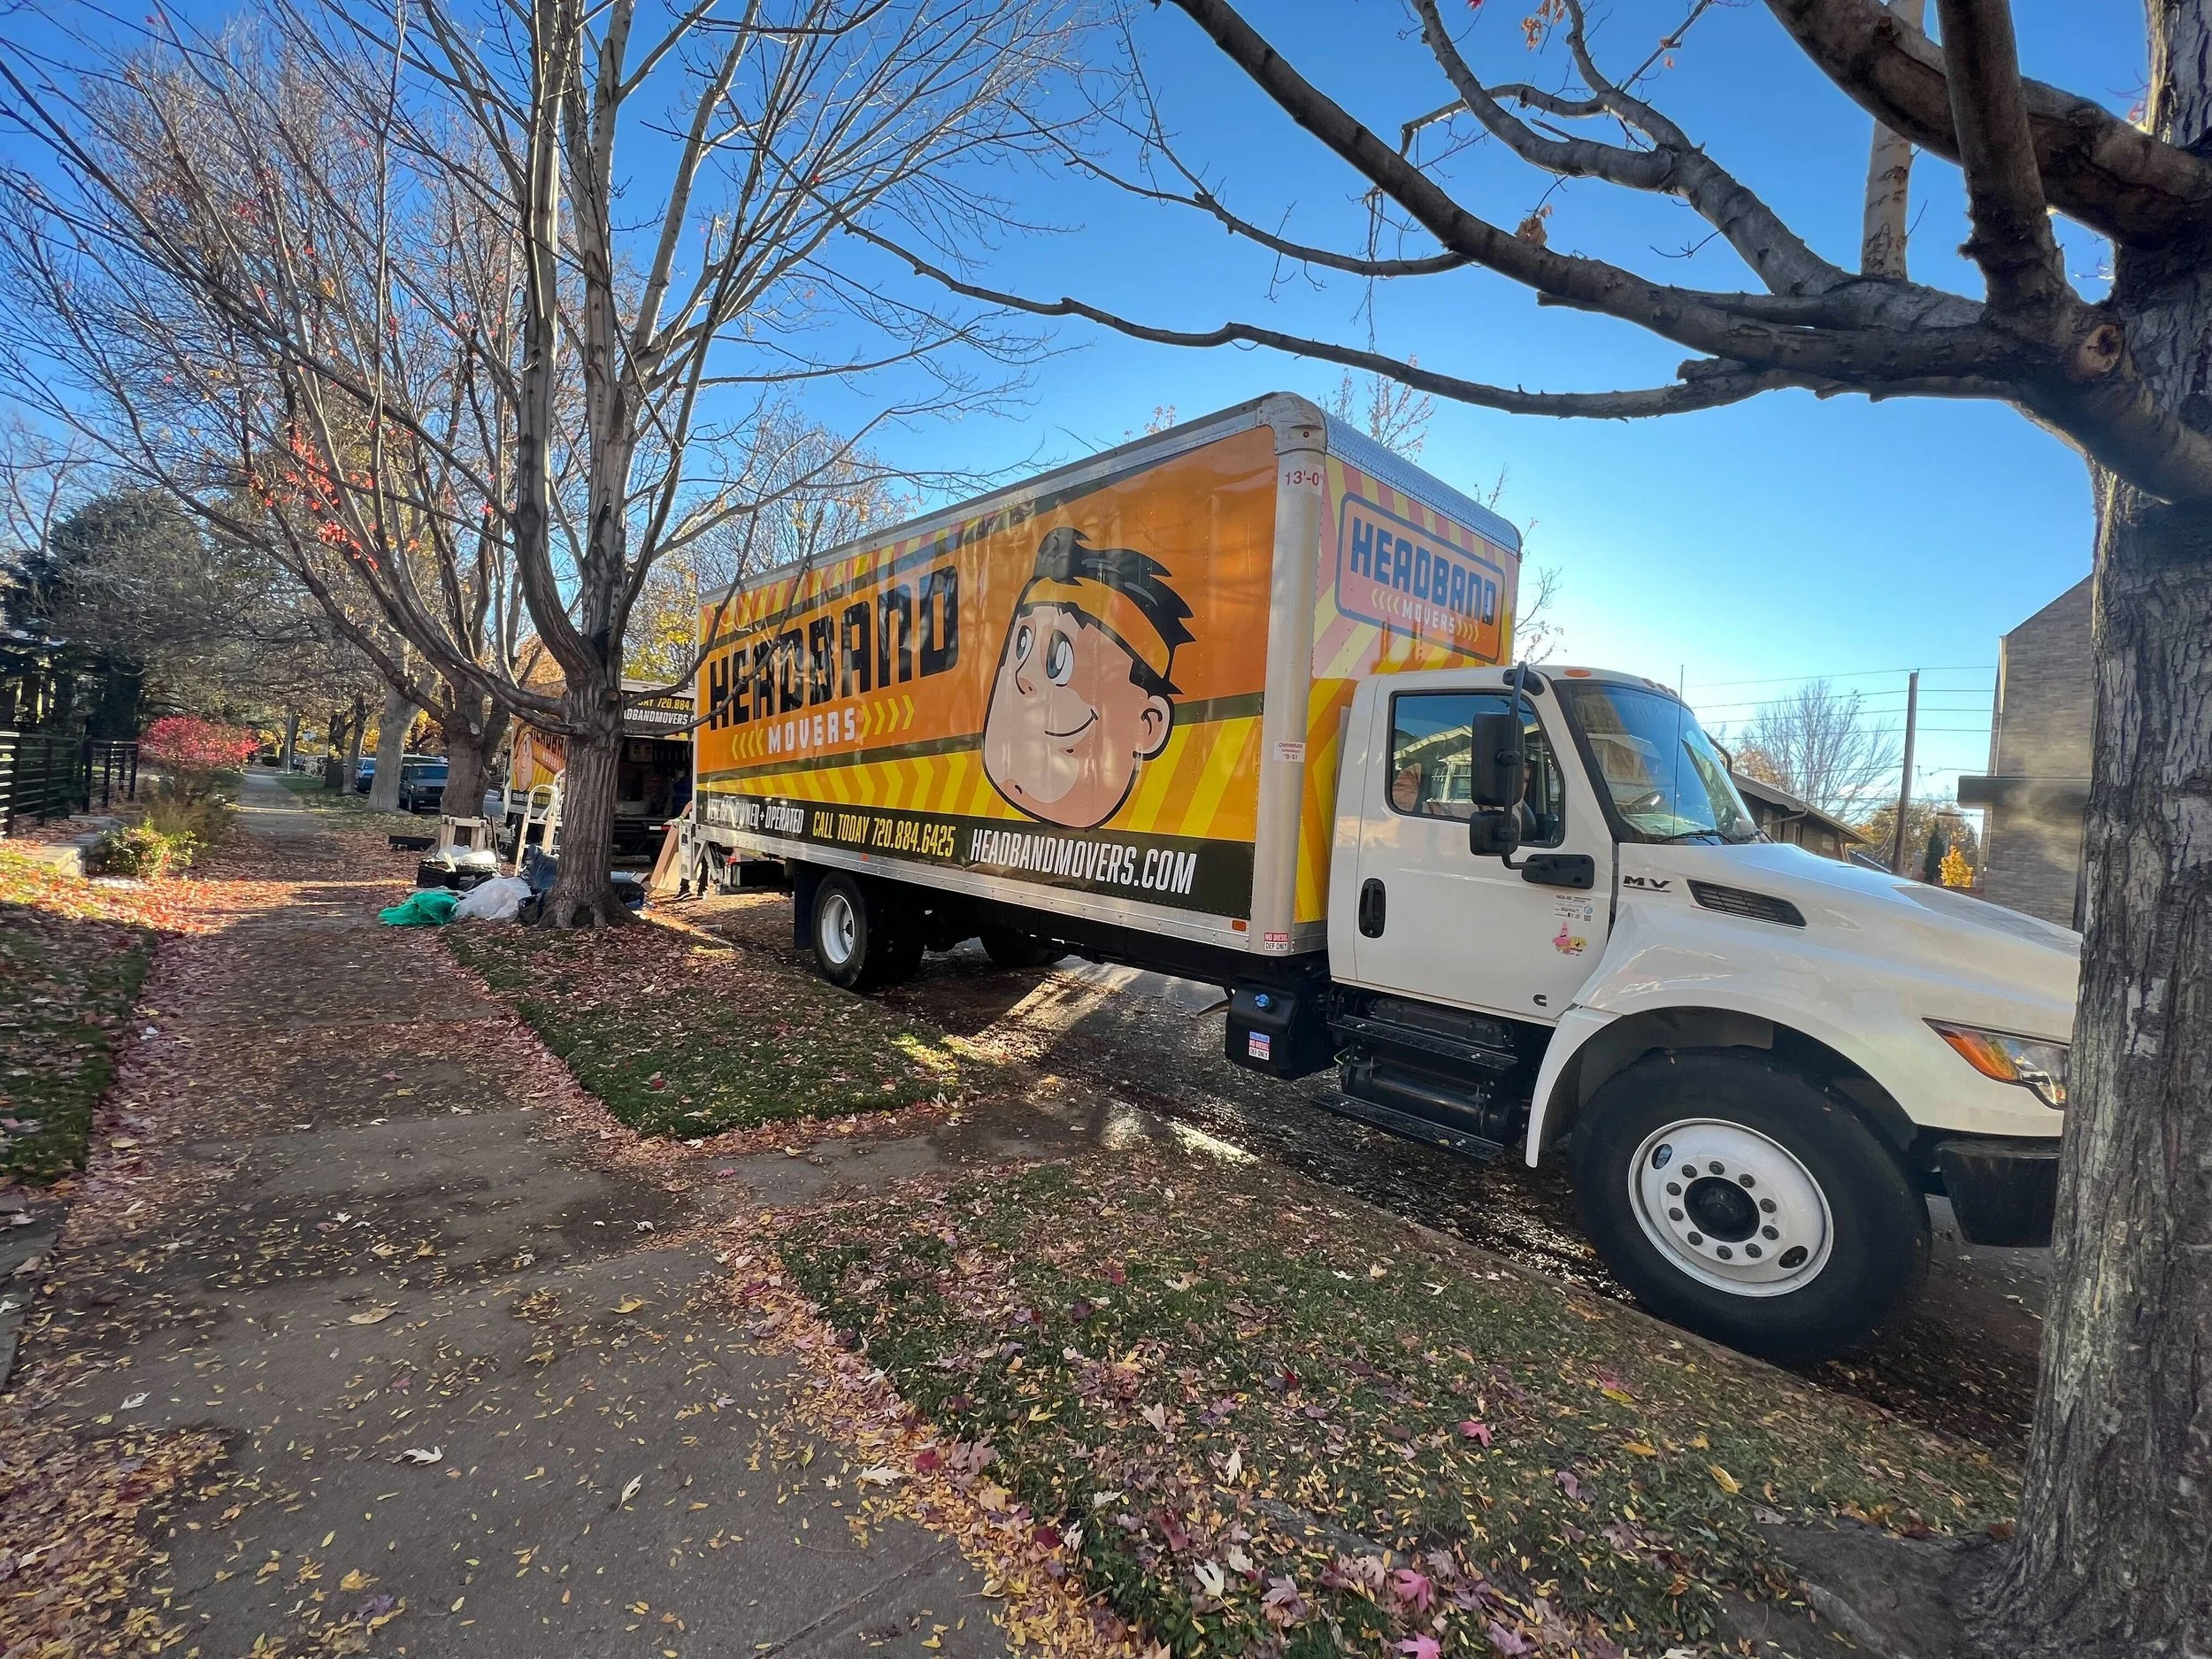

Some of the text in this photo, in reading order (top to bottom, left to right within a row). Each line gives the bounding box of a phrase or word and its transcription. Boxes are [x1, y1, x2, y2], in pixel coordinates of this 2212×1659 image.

[1350, 517, 1497, 626] HEADBAND
[1402, 599, 1455, 634] MOVERS
[710, 565, 959, 731] HEADBAND
[768, 707, 856, 755] MOVERS
[765, 805, 805, 834] OPERATED
[812, 810, 956, 857] CALL TODAY 720.884.6425
[970, 828, 1197, 895] HEADBANDMOVERS.COM
[1624, 875, 1673, 888] MV
